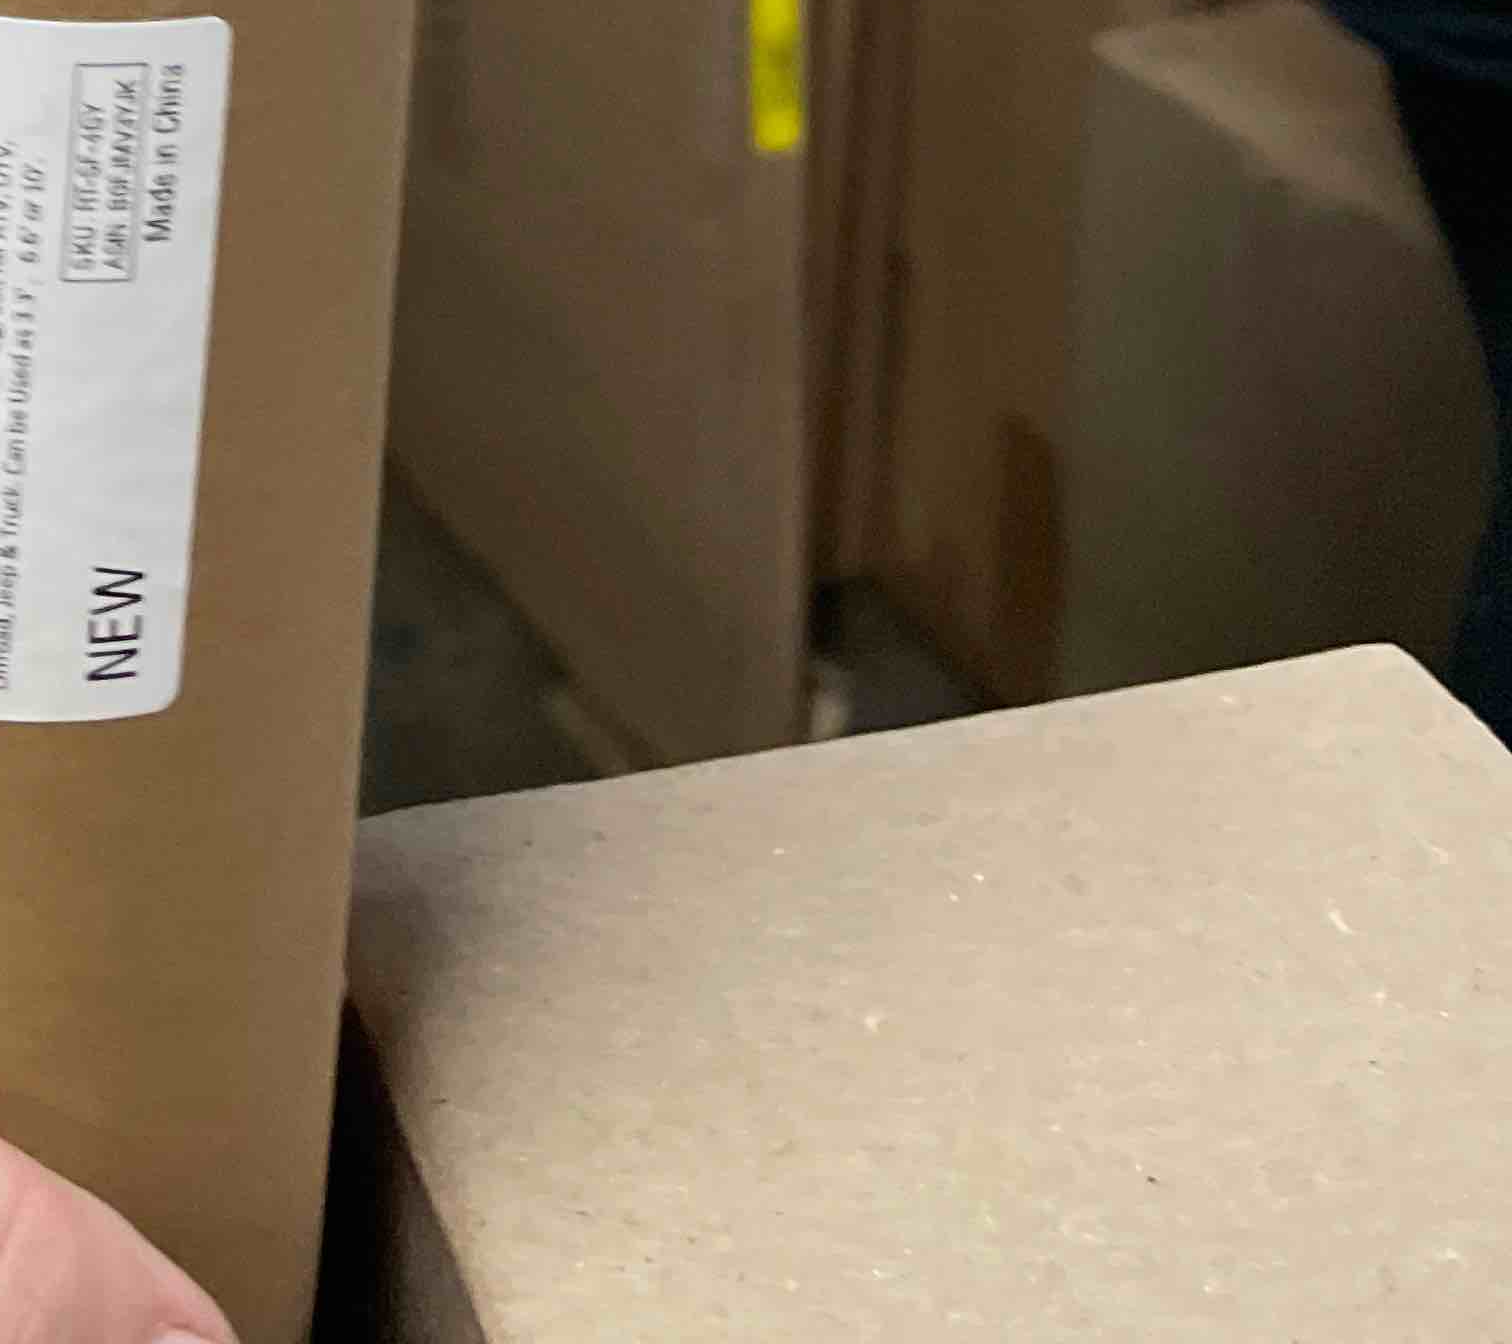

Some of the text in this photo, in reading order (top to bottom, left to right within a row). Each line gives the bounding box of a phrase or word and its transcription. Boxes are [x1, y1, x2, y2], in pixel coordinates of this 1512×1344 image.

[140, 63, 185, 242] Made in China
[6, 352, 31, 403] Used
[5, 408, 28, 433] be
[1, 438, 26, 475] Can
[85, 565, 145, 680] NEW
